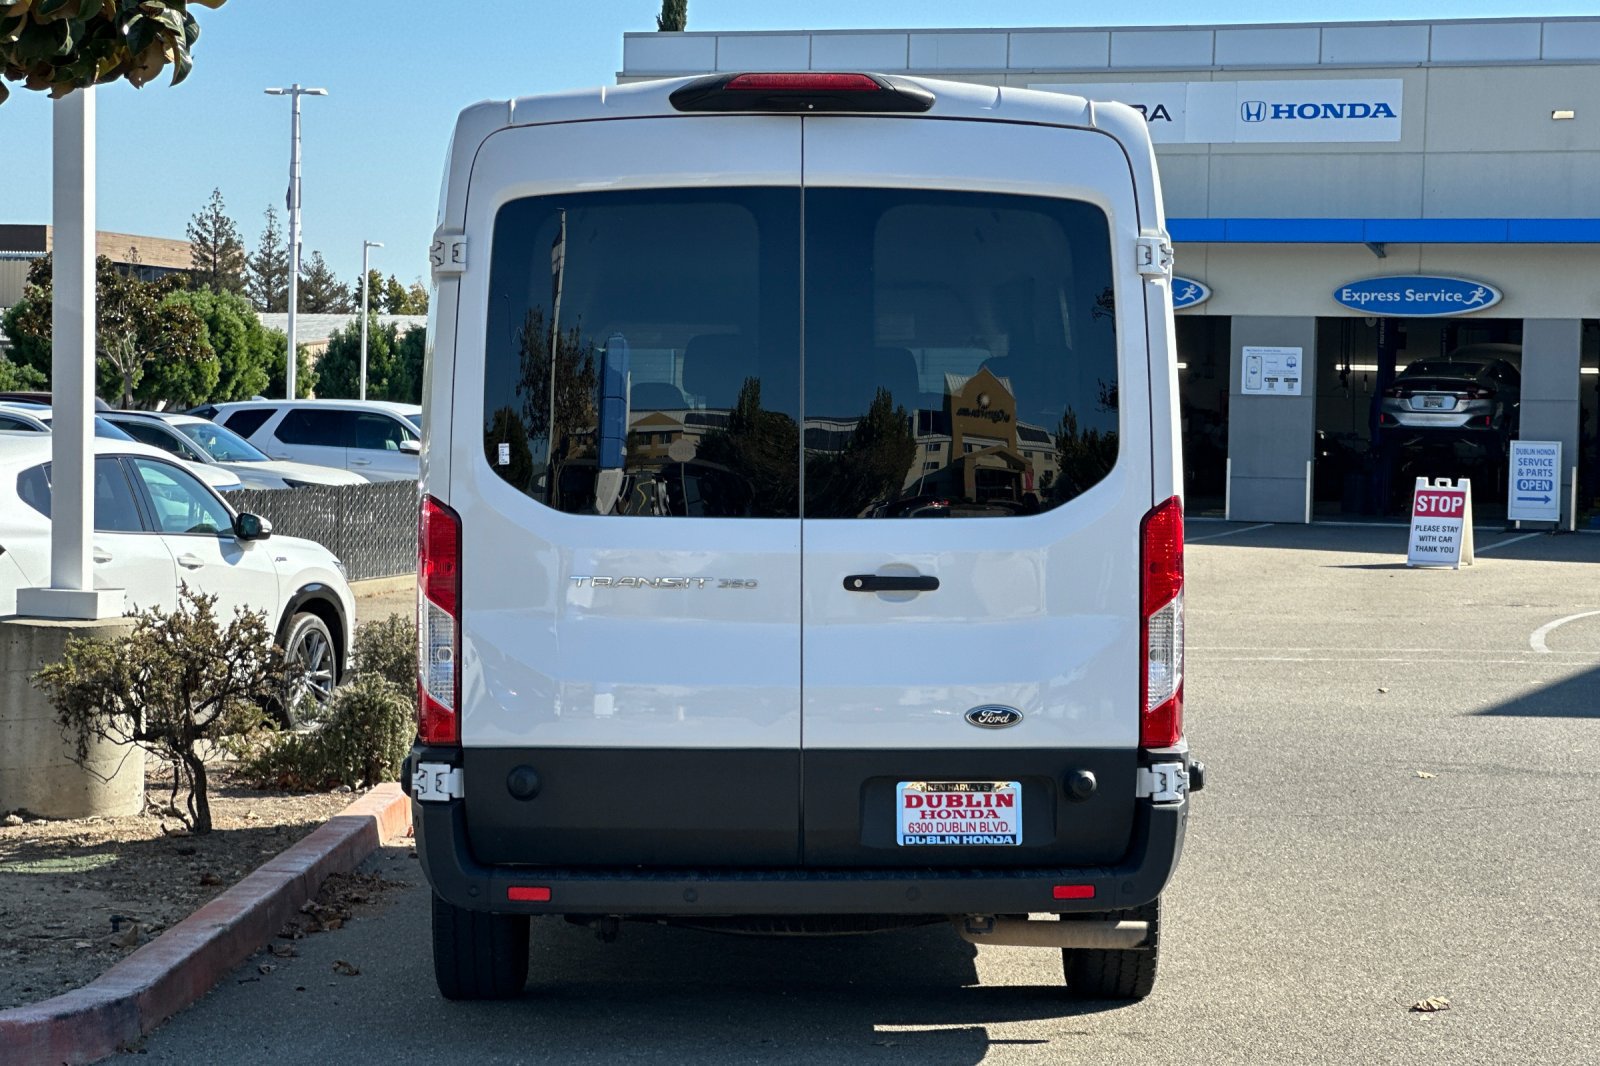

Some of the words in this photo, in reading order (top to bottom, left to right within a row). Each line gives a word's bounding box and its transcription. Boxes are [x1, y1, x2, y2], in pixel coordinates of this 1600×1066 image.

[1271, 103, 1397, 119] HONDA
[1342, 288, 1400, 304] Express
[1405, 290, 1463, 302] Service
[1518, 458, 1552, 466] SERVICE
[1526, 469, 1552, 477] PARTS
[1521, 480, 1549, 490] OPEN
[1417, 495, 1463, 512] STOP
[570, 576, 713, 589] TRANSIT
[716, 578, 758, 589] 350
[978, 710, 1010, 723] Ford
[905, 794, 1014, 808] DUBLIN
[920, 809, 1000, 820] HONDA
[909, 822, 933, 833] 6300
[936, 822, 976, 832] DUBLIN
[980, 822, 1011, 832] BLVD.
[905, 835, 960, 845] DUBLIN
[963, 835, 1013, 844] HONDA
